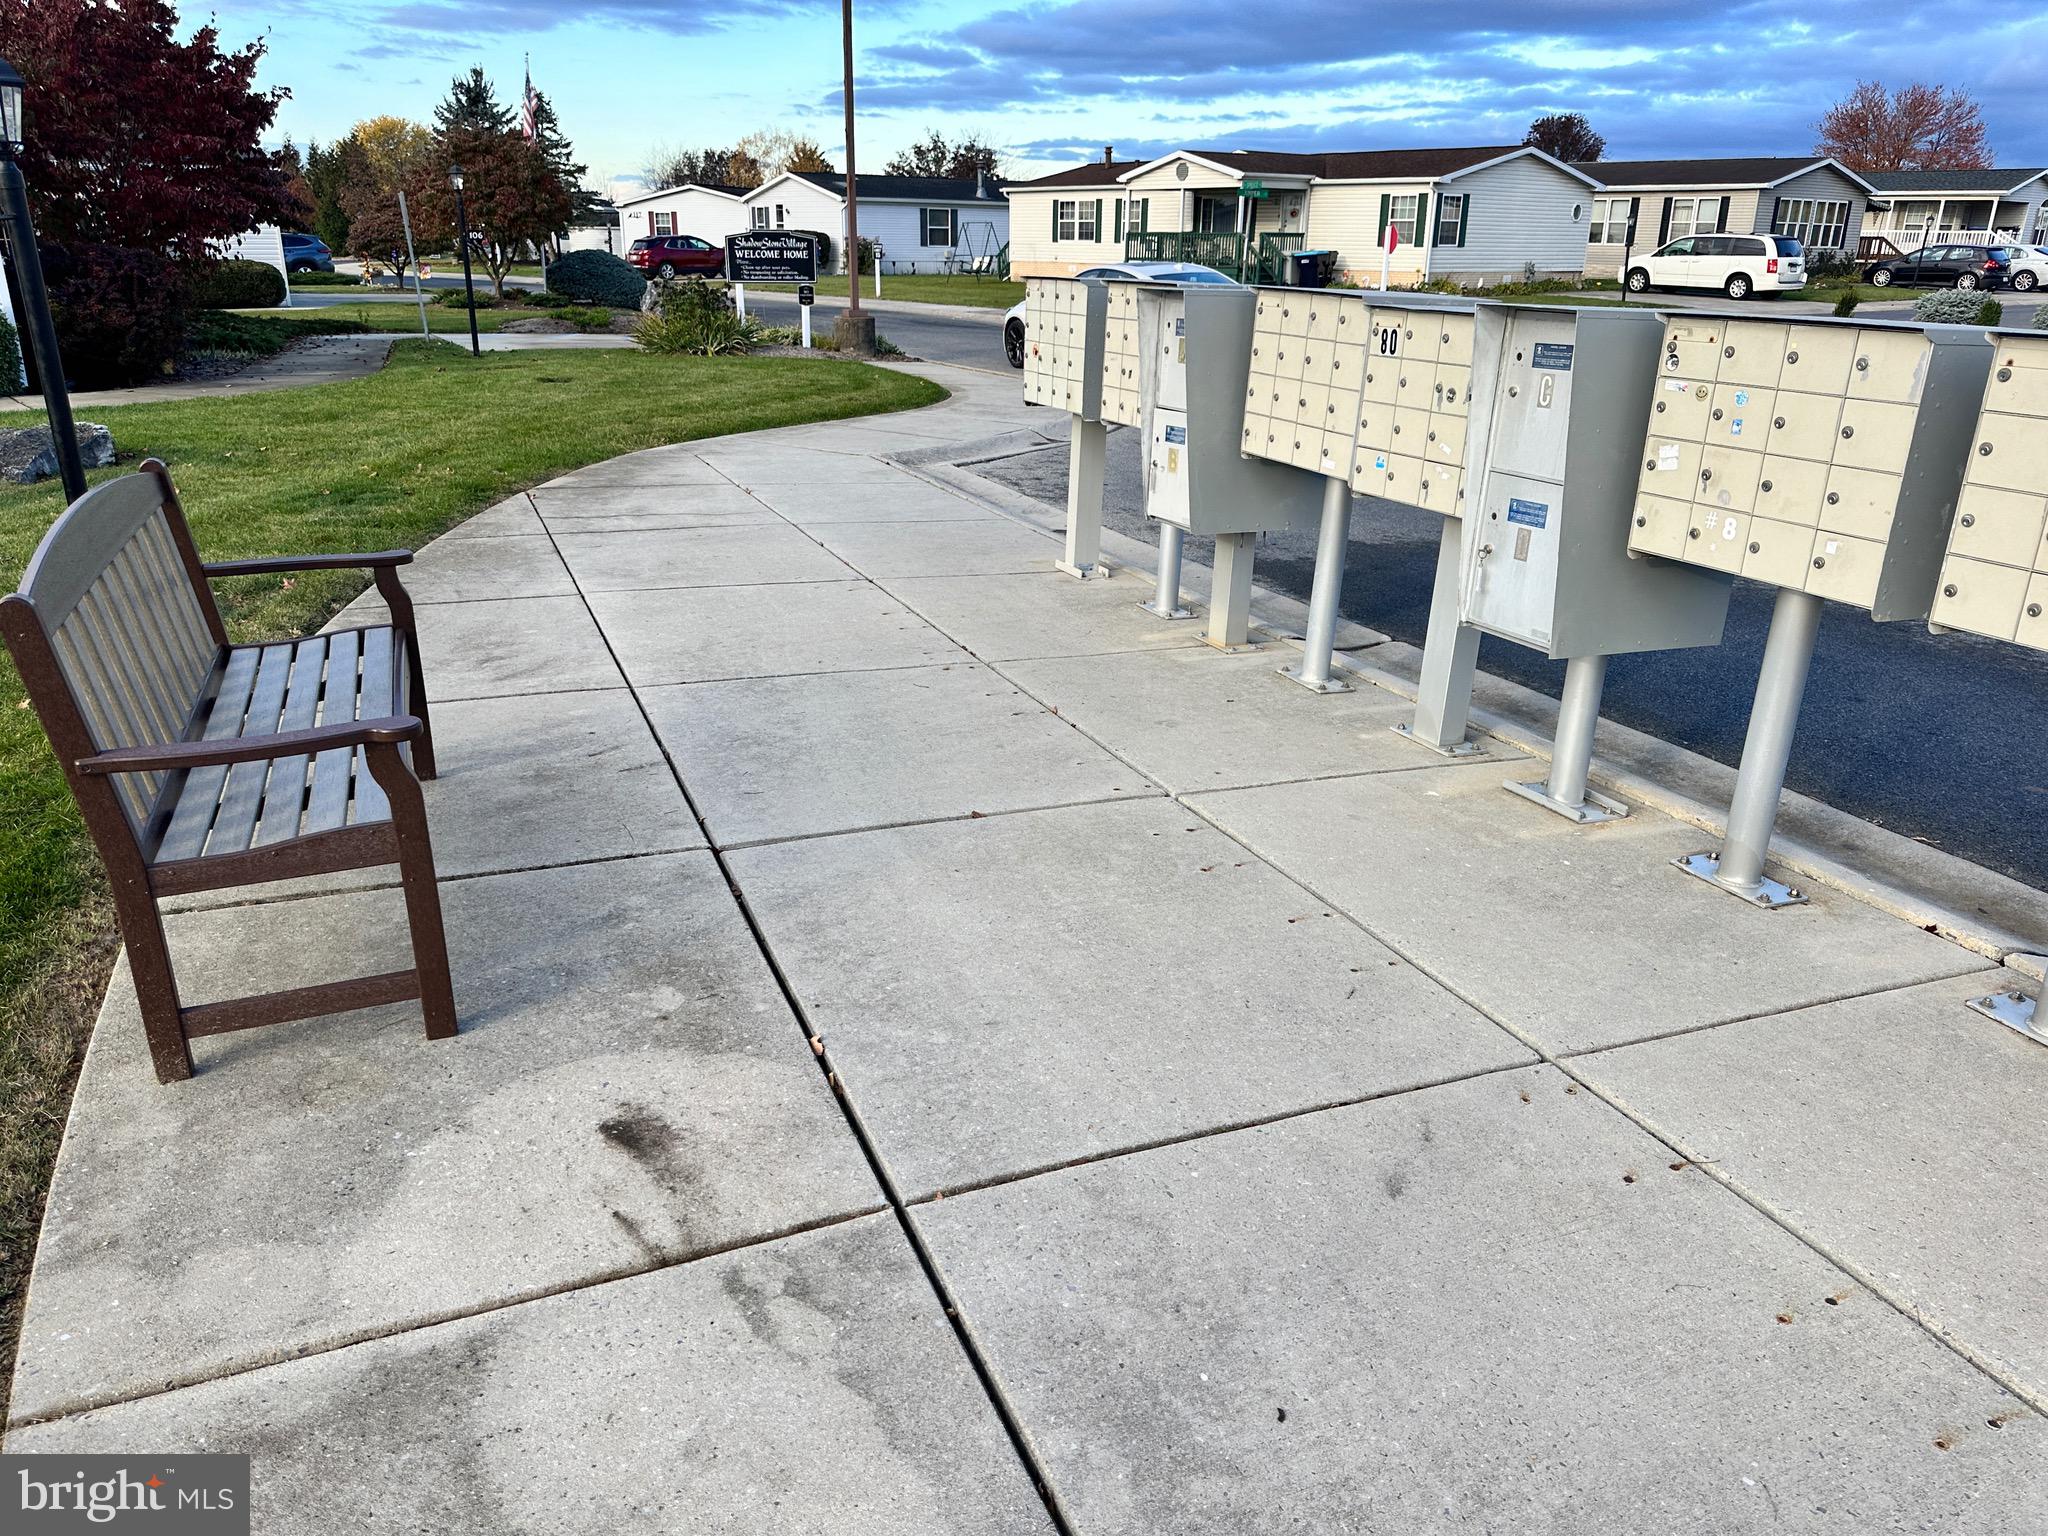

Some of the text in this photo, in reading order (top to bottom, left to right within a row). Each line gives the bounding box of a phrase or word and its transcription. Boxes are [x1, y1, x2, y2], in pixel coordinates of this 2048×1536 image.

[469, 231, 483, 239] 106
[735, 250, 809, 259] WELCOME HOME
[1381, 328, 1398, 355] 80
[1540, 375, 1552, 406] C
